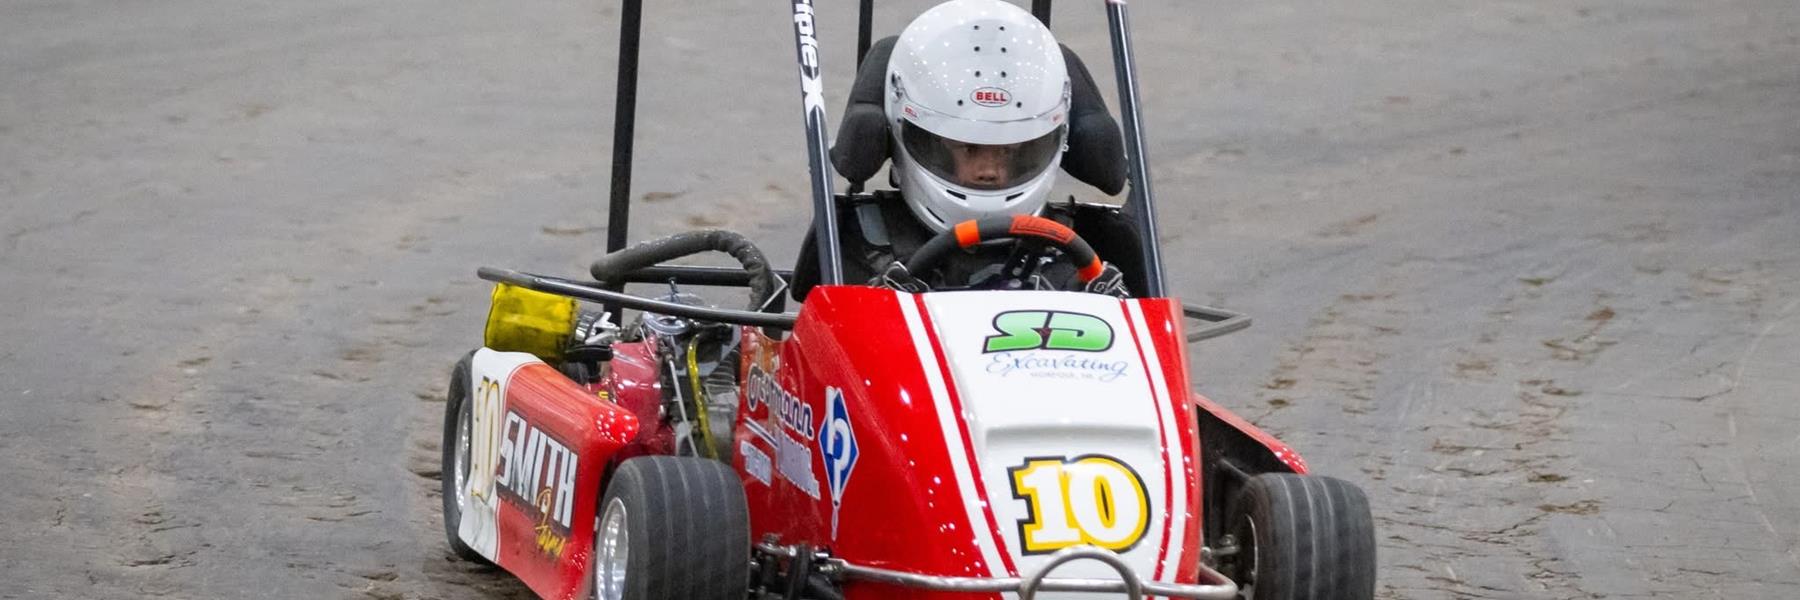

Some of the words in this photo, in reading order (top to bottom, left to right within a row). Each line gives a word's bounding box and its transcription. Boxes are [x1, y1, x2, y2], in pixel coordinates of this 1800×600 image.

[976, 91, 1008, 102] BELL
[982, 310, 1115, 354] SD
[986, 352, 1129, 382] Excavating
[471, 375, 499, 505] 10
[497, 410, 579, 530] SMITH
[1007, 453, 1152, 556] 10
